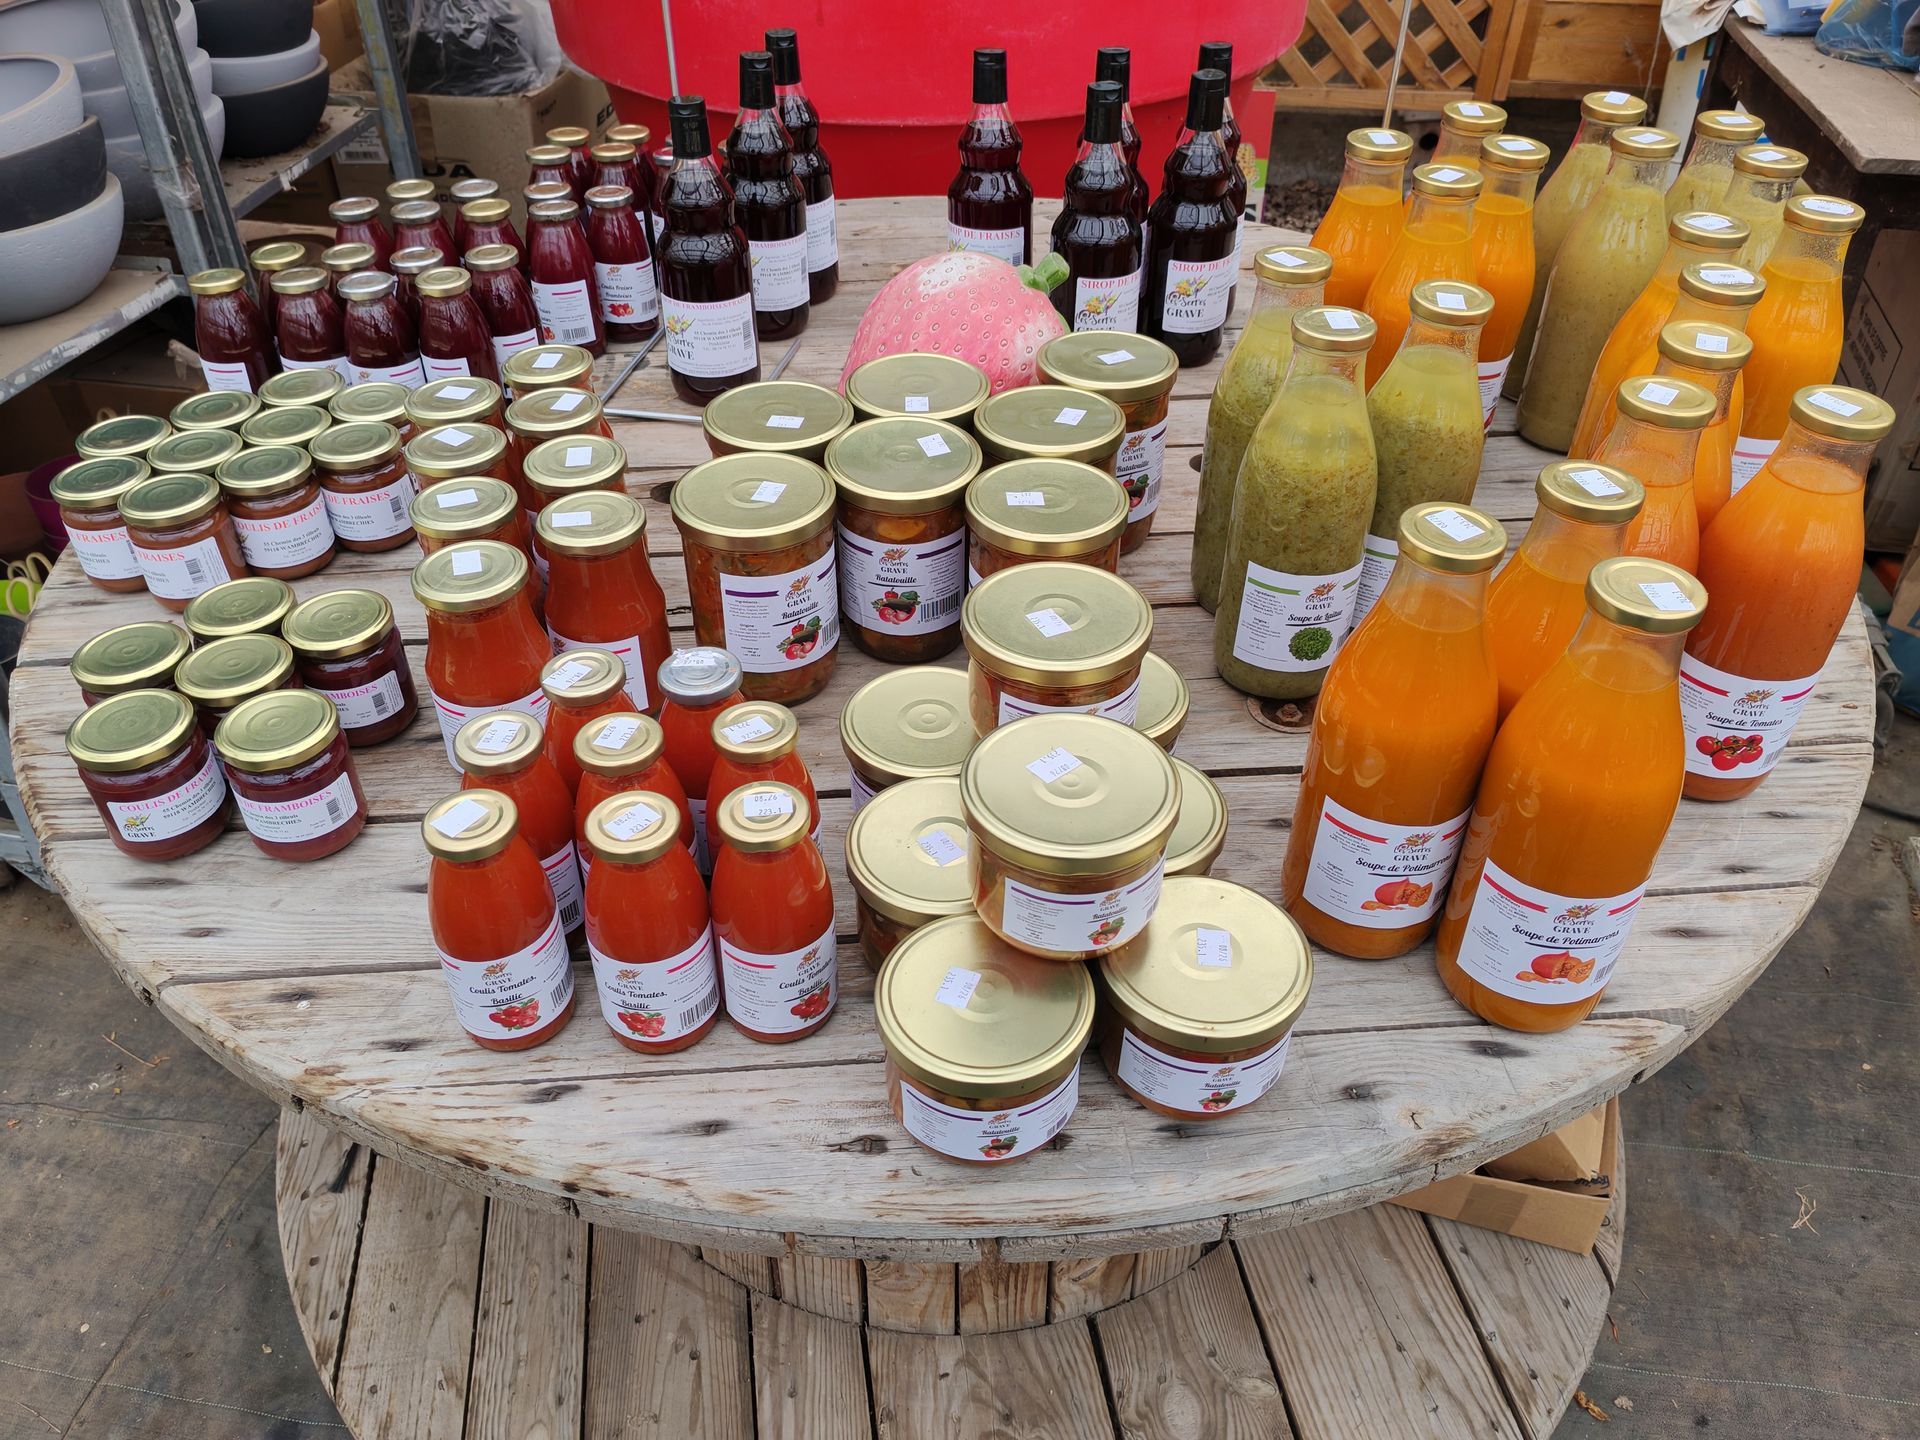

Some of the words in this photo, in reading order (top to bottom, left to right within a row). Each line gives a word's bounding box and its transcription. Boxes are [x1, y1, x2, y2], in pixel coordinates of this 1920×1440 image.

[1172, 262, 1206, 272] SIROP
[1081, 279, 1115, 289] SIROP
[1166, 307, 1205, 318] GRAVE
[342, 492, 391, 506] FRAISES
[274, 521, 290, 530] DE
[881, 566, 908, 574] GRAVE
[875, 574, 917, 584] Ratatouille
[787, 597, 811, 608] GRAVE
[1305, 602, 1332, 611] GRAVE
[781, 601, 819, 620] Ratatouille
[1288, 613, 1313, 623] Soupe
[1313, 614, 1324, 622] de
[326, 683, 378, 699] AMBOISES
[1732, 708, 1765, 717] GRAVE
[1706, 711, 1734, 726] Soupe
[1735, 718, 1748, 727] de
[1750, 719, 1782, 728] Tomates
[119, 799, 166, 812] COULIS
[167, 792, 181, 803] DE
[258, 790, 332, 813] FRAMBOISES
[1356, 857, 1386, 871] Soupe
[1387, 864, 1400, 872] de
[1402, 853, 1453, 872] Potimarrons
[1512, 924, 1545, 941] Soupe
[1545, 935, 1559, 944] de
[1562, 930, 1620, 945] Potimarrons
[1553, 926, 1591, 934] GRAVE
[469, 986, 496, 994] Coulis
[497, 975, 537, 993] Tomates,
[780, 977, 805, 990] Coulis
[798, 978, 823, 996] Basilic
[604, 982, 626, 996] Coulis
[627, 991, 668, 999] Tomates,
[491, 993, 523, 1005] Basilic
[620, 999, 652, 1009] Basilic
